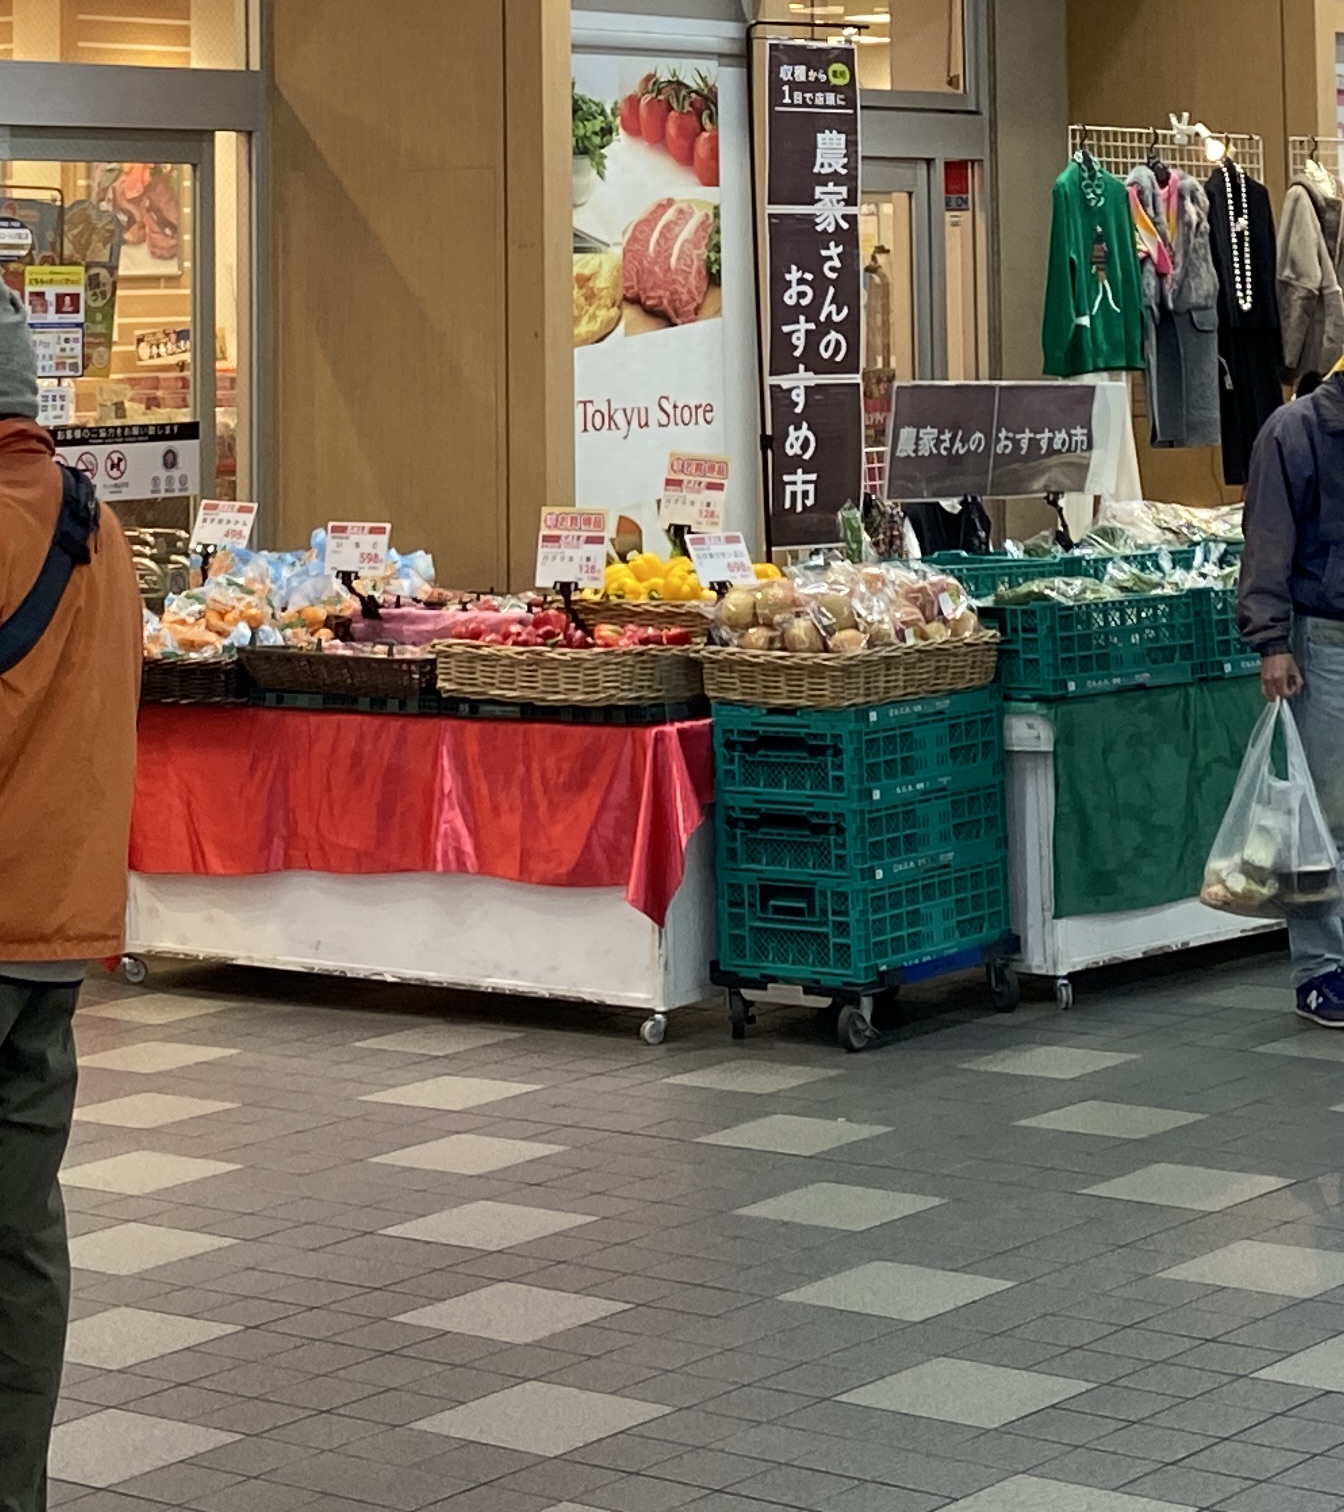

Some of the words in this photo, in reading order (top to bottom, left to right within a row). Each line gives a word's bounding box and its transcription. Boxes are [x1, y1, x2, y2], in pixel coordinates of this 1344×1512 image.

[812, 130, 850, 362] 農家さんの
[577, 399, 650, 439] Tokyu
[657, 395, 715, 429] Store
[780, 265, 817, 514] おすすめ市
[895, 426, 986, 458] 農家さんの
[996, 426, 1089, 456] おすすめ市
